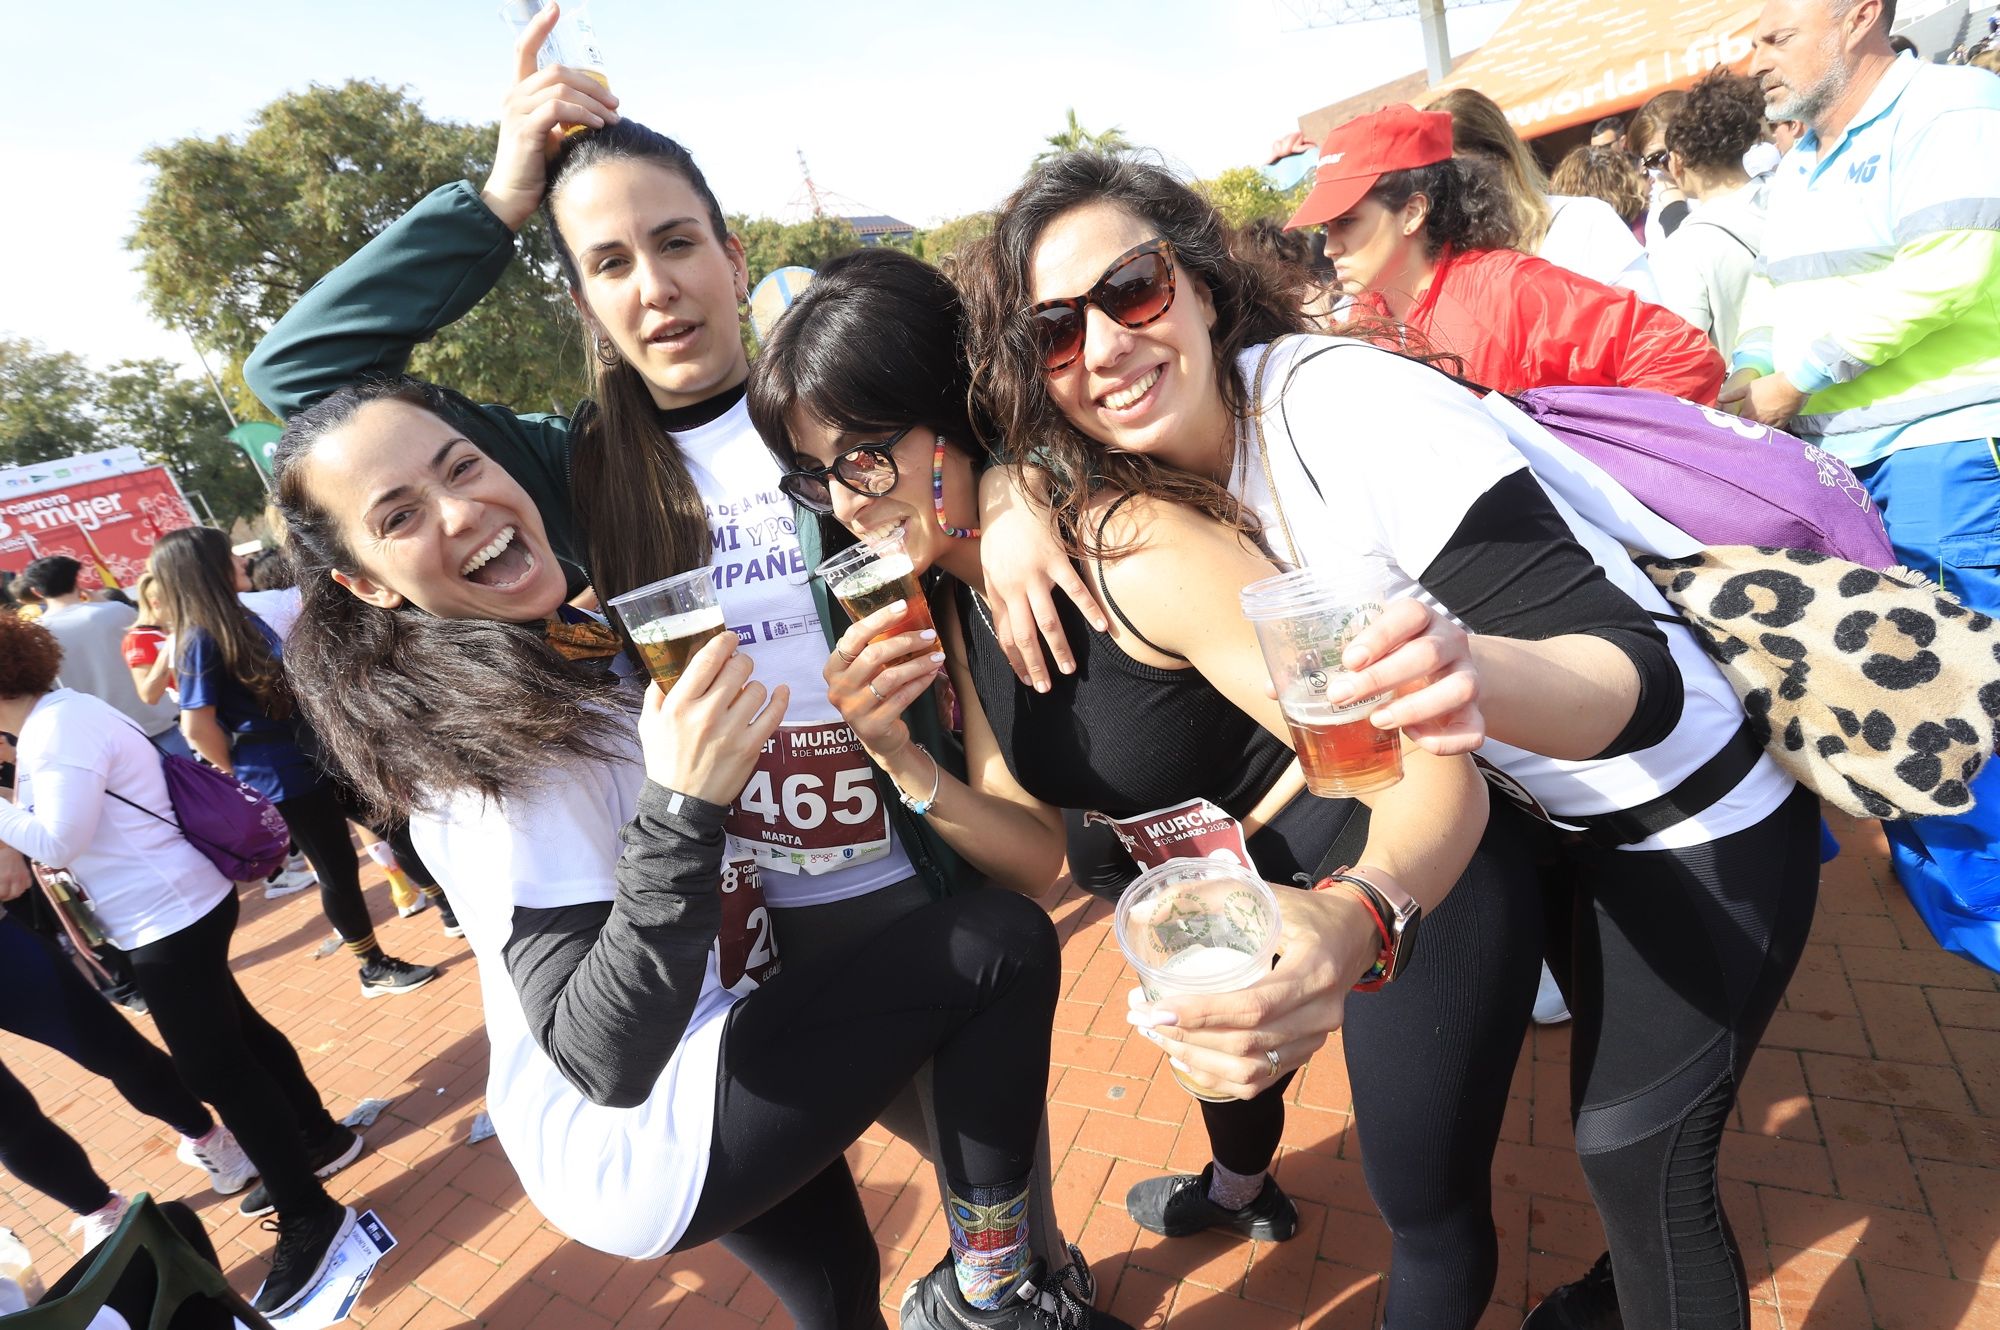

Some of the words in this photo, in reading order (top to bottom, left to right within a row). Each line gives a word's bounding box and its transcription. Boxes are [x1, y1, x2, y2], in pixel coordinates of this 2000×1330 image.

[1503, 59, 1648, 127] world
[6, 494, 70, 516] carrera
[32, 492, 122, 532] mujer
[719, 503, 739, 517] DE
[746, 522, 762, 547] Y
[792, 749, 798, 757] 5
[800, 748, 812, 757] DE
[815, 745, 849, 756] MARZO
[729, 766, 878, 830] 465
[762, 830, 802, 846] MARTA
[1161, 836, 1175, 846] DE
[1174, 827, 1207, 842] MARZO
[1208, 821, 1231, 833] 2023
